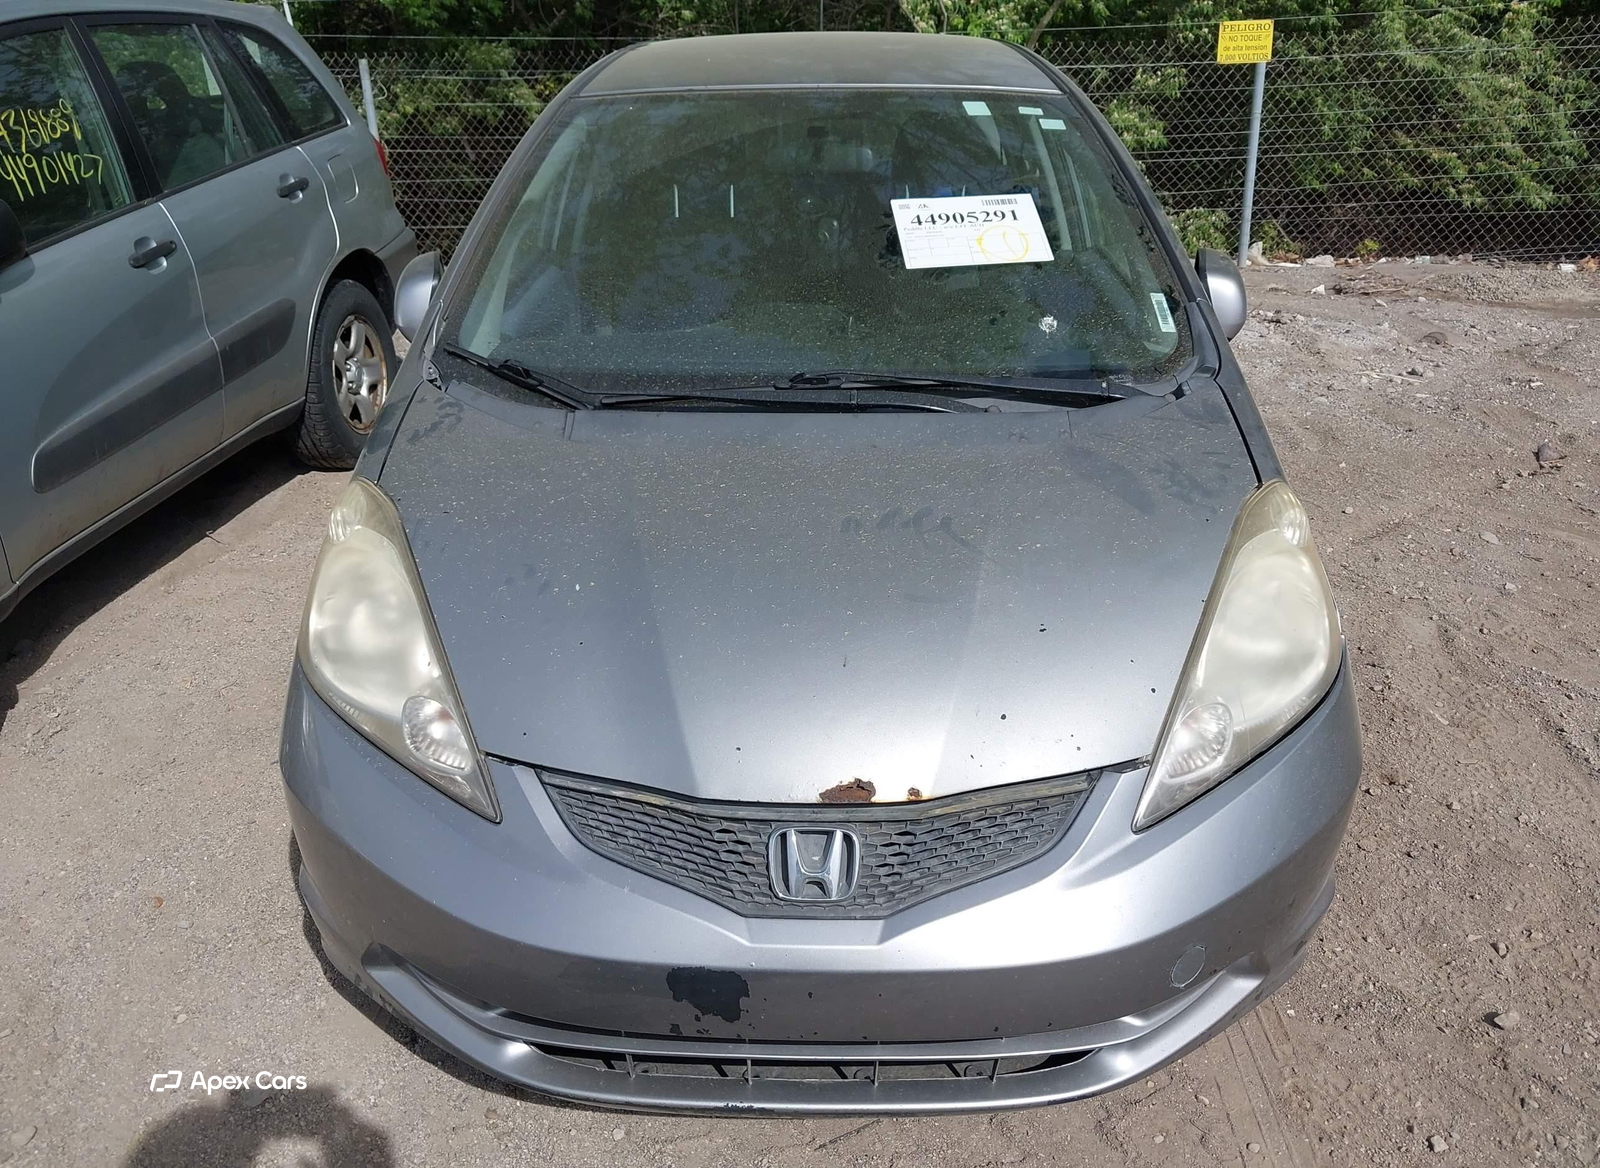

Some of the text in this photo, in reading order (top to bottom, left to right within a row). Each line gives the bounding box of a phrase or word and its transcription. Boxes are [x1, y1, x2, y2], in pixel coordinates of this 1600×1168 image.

[1222, 23, 1271, 32] PELIGRO
[1240, 34, 1263, 42] TOQUE
[1237, 52, 1269, 61] VOLTIOS
[910, 209, 1019, 226] 44905291
